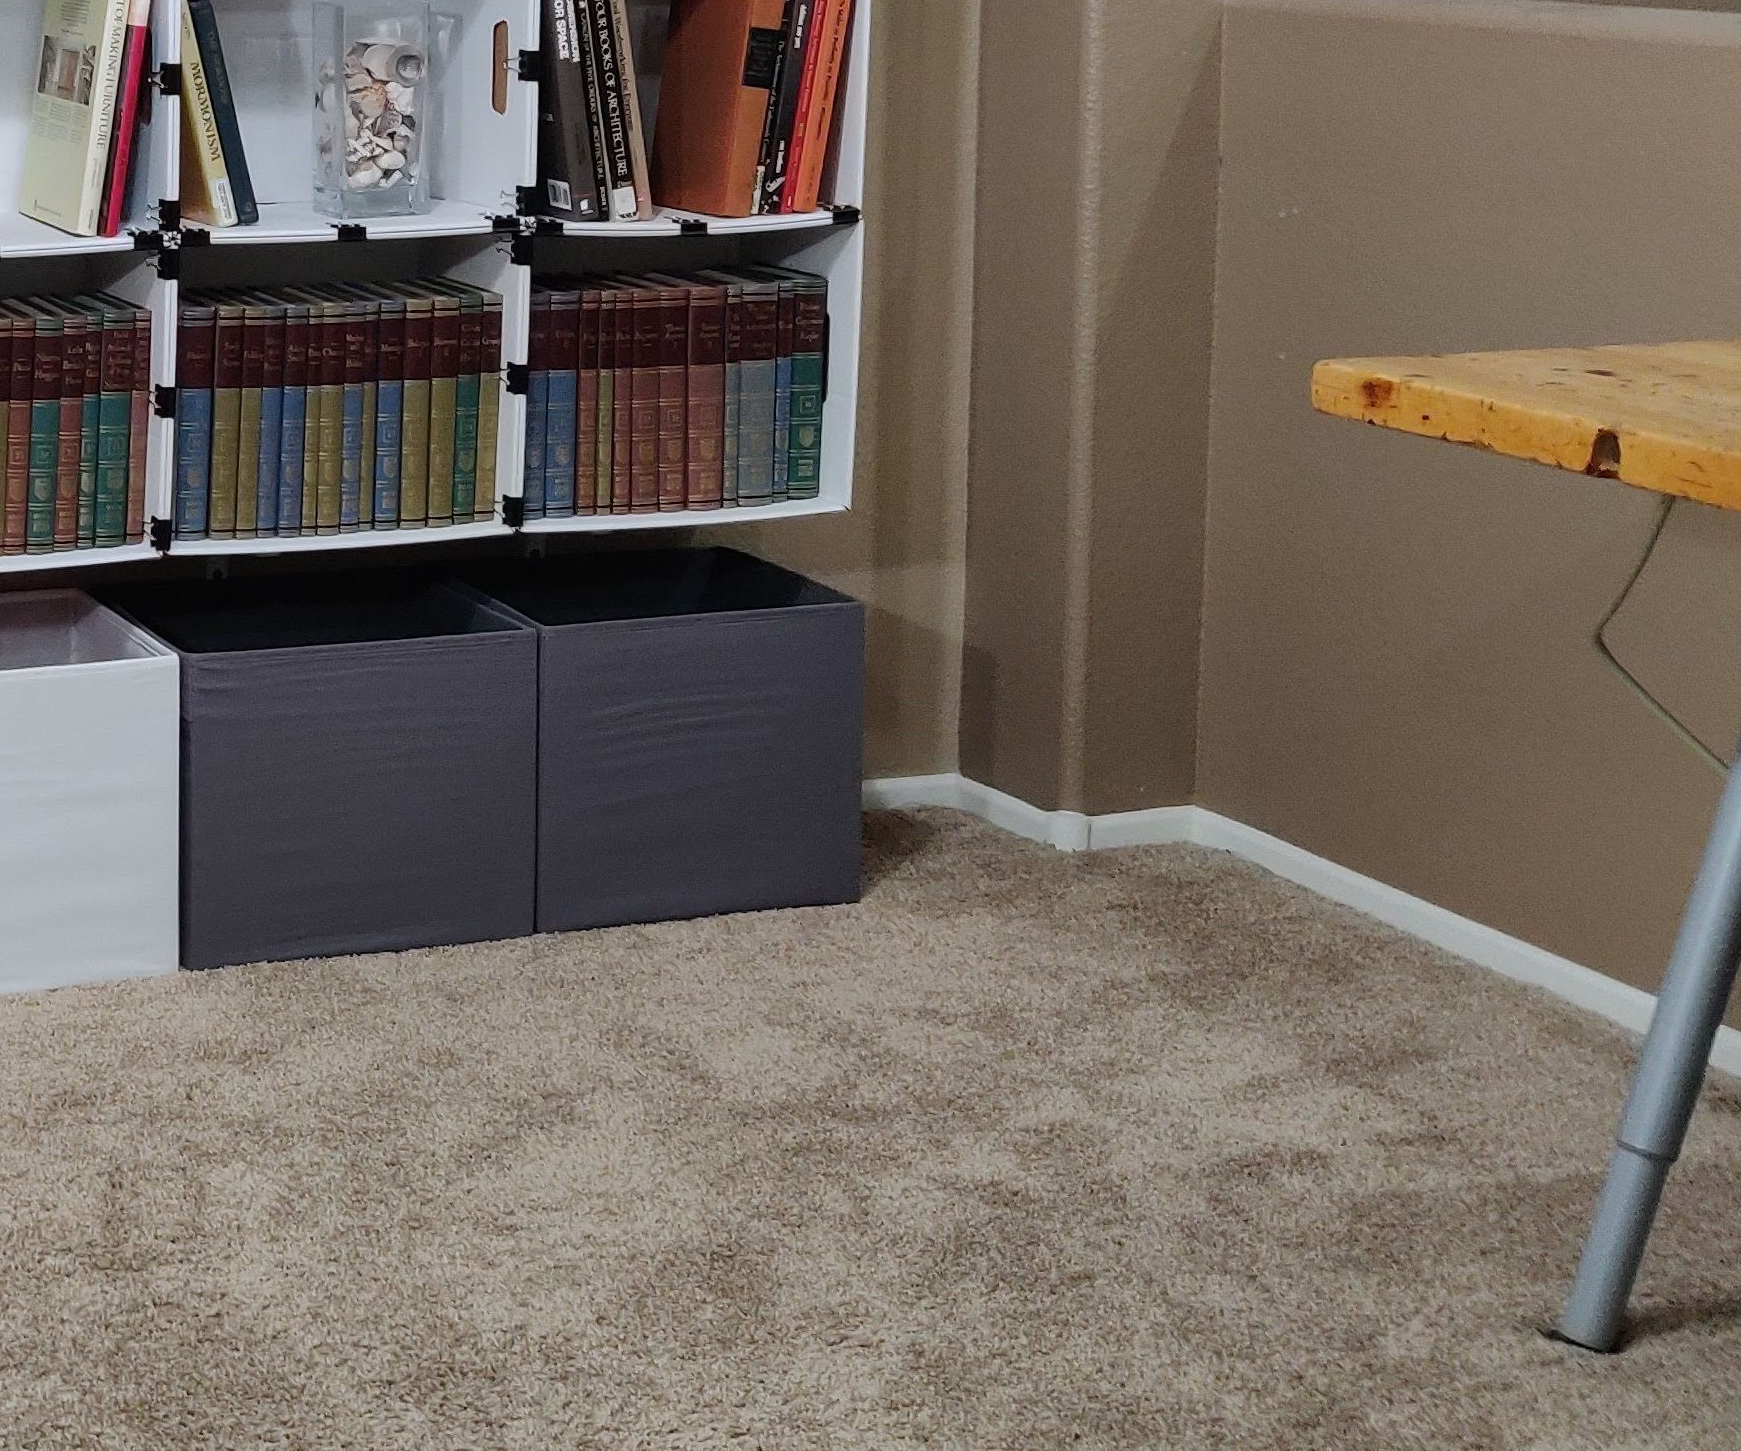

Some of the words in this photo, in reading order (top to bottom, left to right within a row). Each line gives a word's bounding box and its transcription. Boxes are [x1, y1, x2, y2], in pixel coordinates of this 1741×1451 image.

[105, 26, 122, 77] MAKING
[556, 20, 569, 60] SPACE
[598, 29, 613, 70] BOOKS
[604, 72, 615, 88] OF
[95, 77, 115, 149] FURNITURE
[189, 61, 220, 161] MORMONISM
[606, 89, 627, 176] ARCHITECTURE
